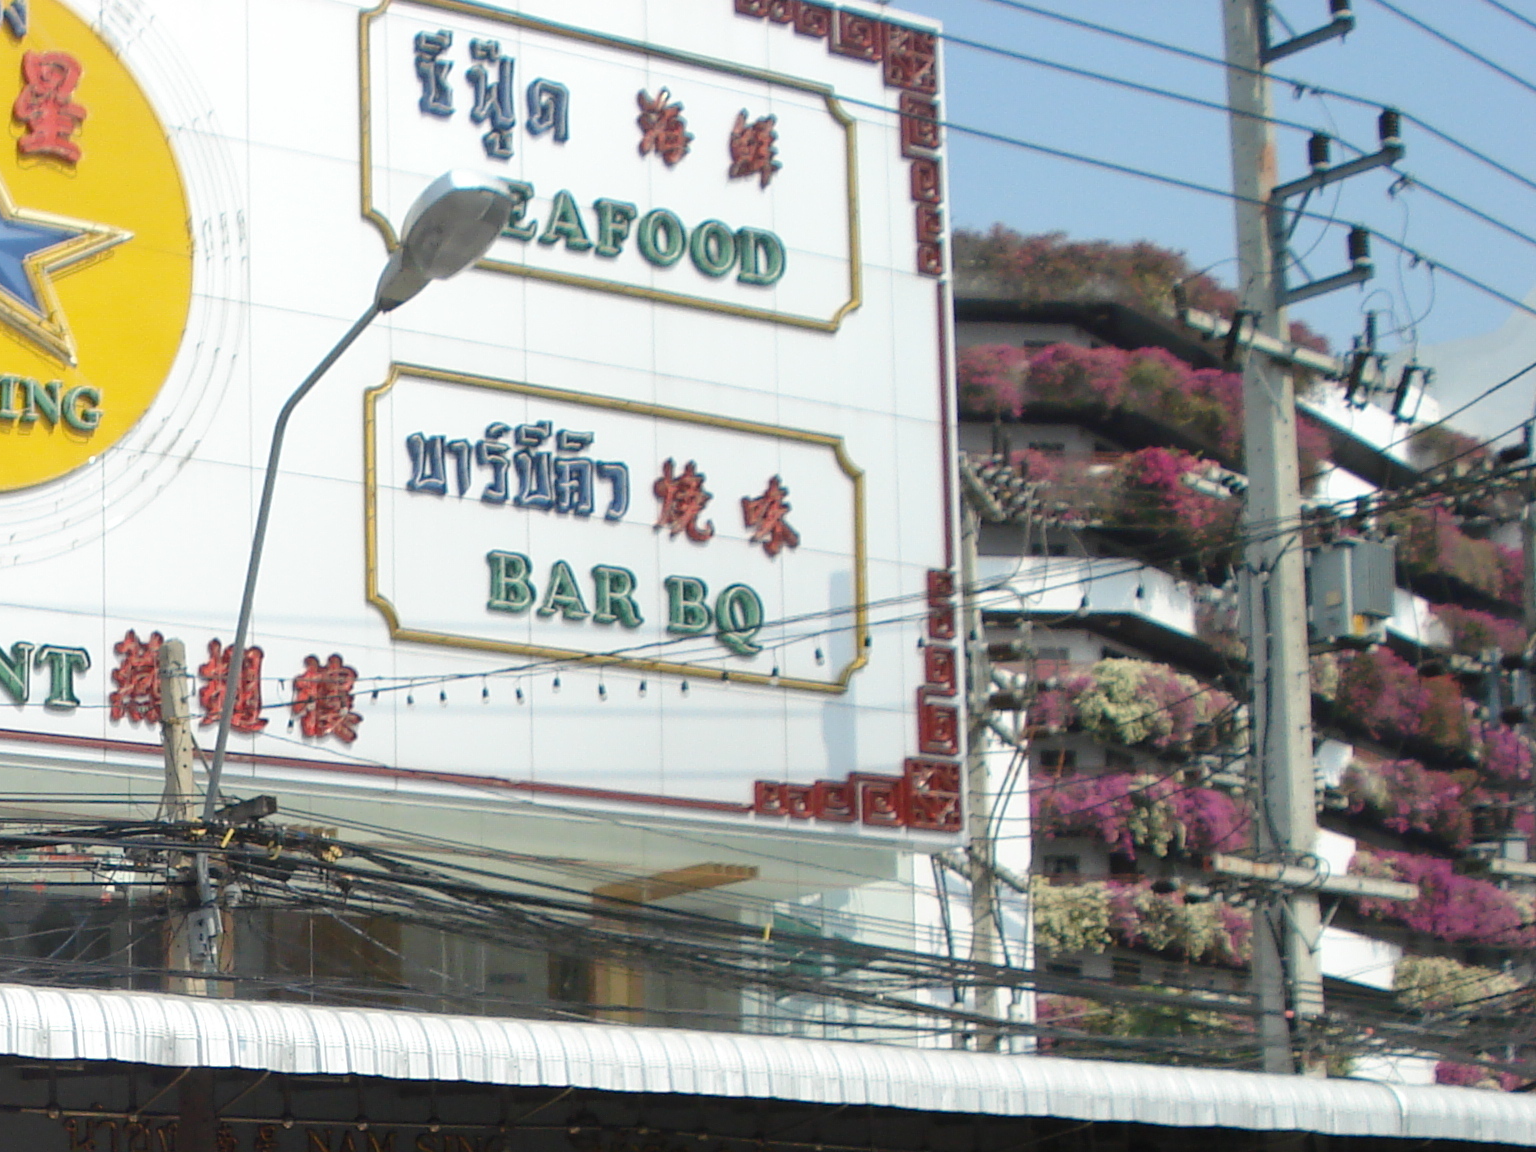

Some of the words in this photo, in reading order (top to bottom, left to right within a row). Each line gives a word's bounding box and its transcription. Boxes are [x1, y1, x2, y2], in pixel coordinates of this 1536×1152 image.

[500, 178, 787, 287] EAFOOD
[487, 549, 643, 630] BAR
[665, 576, 766, 657] BQ
